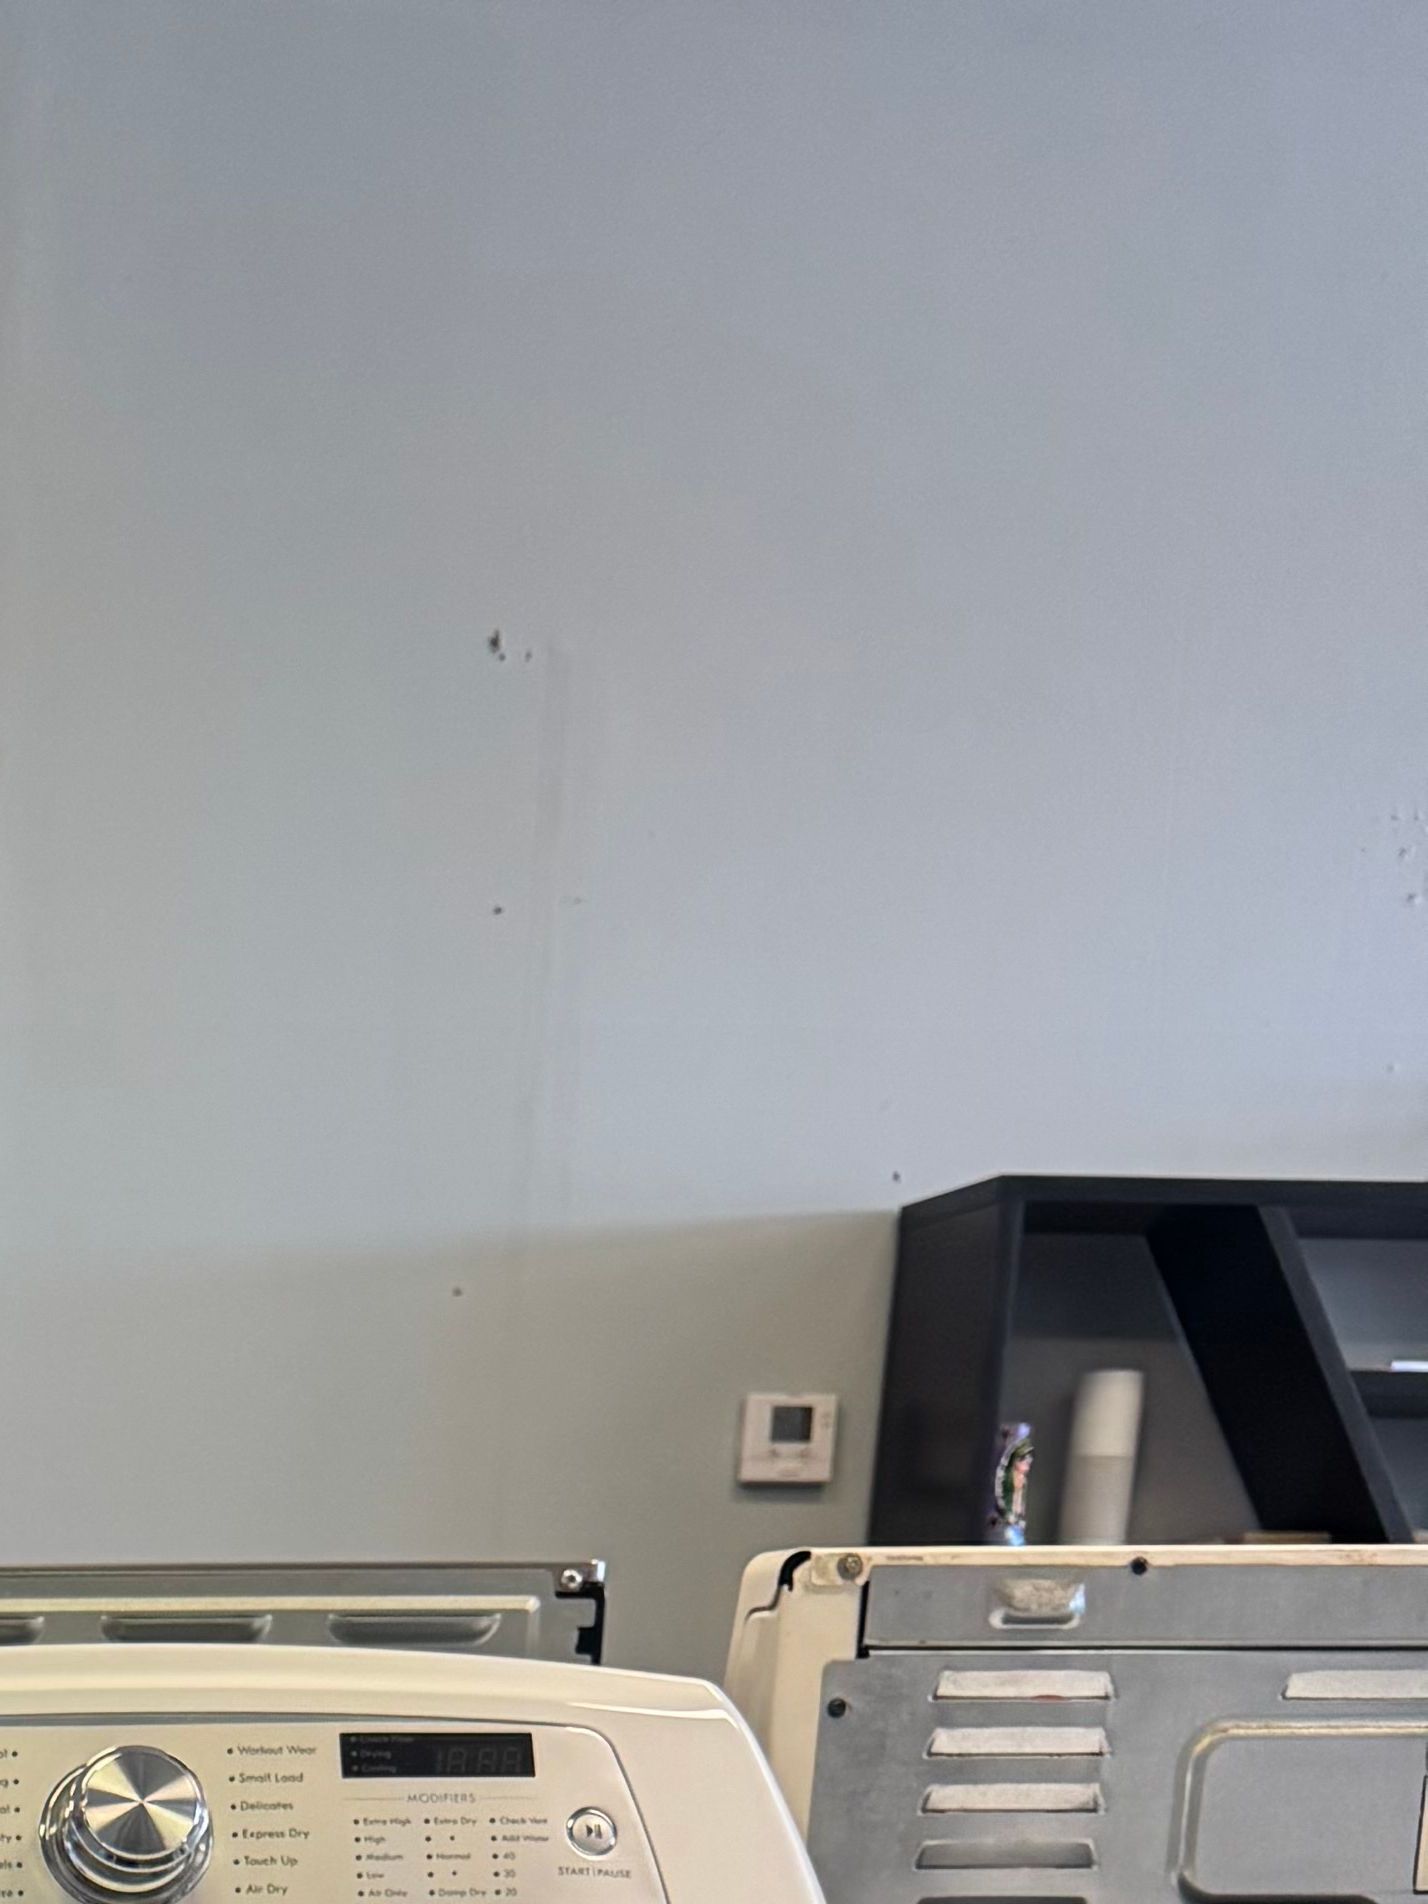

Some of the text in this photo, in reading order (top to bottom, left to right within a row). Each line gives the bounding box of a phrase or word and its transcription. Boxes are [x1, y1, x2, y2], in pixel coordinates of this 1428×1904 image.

[237, 1745, 317, 1756] Workout Wear
[239, 1772, 304, 1784] Small Load
[407, 1793, 477, 1804] MODIFIERS
[240, 1800, 294, 1811] Delicates
[460, 1816, 477, 1827] Dry
[242, 1827, 310, 1840] Express Dry
[244, 1855, 299, 1868] Touch Up
[246, 1883, 288, 1896] Air Dry
[469, 1887, 487, 1897] Dry
